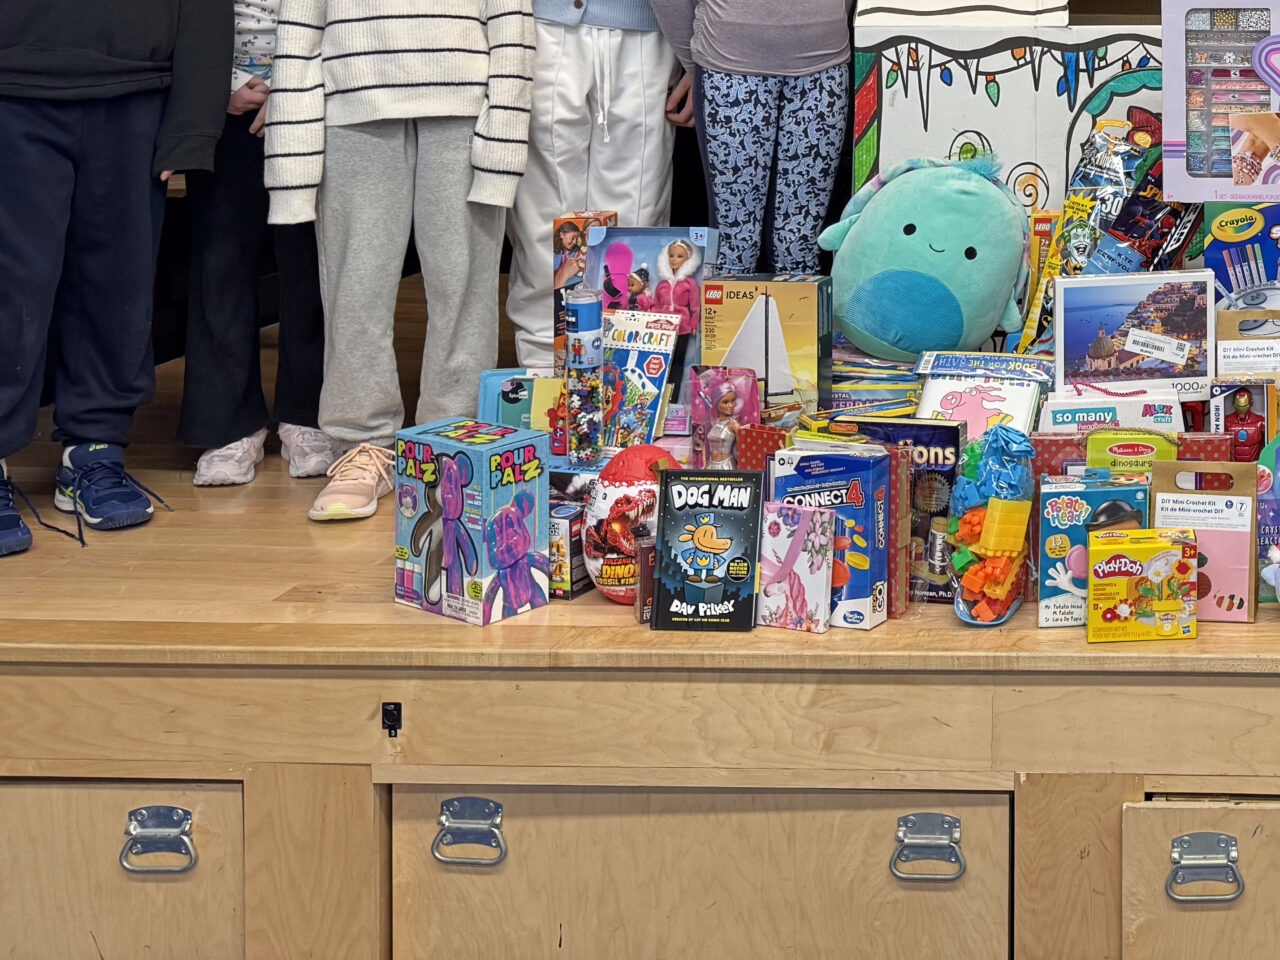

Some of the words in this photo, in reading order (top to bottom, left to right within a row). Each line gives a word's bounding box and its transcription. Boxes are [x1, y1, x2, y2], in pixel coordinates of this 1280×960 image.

[1101, 195, 1122, 216] 30
[1218, 213, 1256, 229] Crayola
[706, 290, 722, 299] LEGO
[726, 291, 754, 299] IDEAS
[612, 329, 640, 344] COLOR
[642, 331, 671, 347] CRAFT
[968, 360, 985, 368] THE
[1008, 363, 1037, 371] BOOK
[1171, 382, 1200, 392] 1000
[1056, 413, 1072, 422] so
[1075, 411, 1112, 424] many
[419, 426, 504, 444] PALZ
[449, 420, 519, 436] POUR
[397, 440, 433, 463] POUR
[490, 445, 536, 472] POUR
[397, 456, 438, 483] PALZ
[1110, 459, 1153, 467] dinosaurs
[490, 458, 542, 489] PALZ
[671, 484, 710, 509] DOG
[712, 484, 751, 508] MAN
[782, 489, 848, 507] CONNECT
[847, 480, 863, 506] 4
[1047, 496, 1086, 513] Potato
[878, 500, 886, 550] CONNECT
[1050, 511, 1083, 527] Head
[1184, 548, 1195, 557] 3+
[602, 565, 635, 578] DINO
[1094, 558, 1142, 577] Play-Doh
[669, 599, 695, 615] DAV
